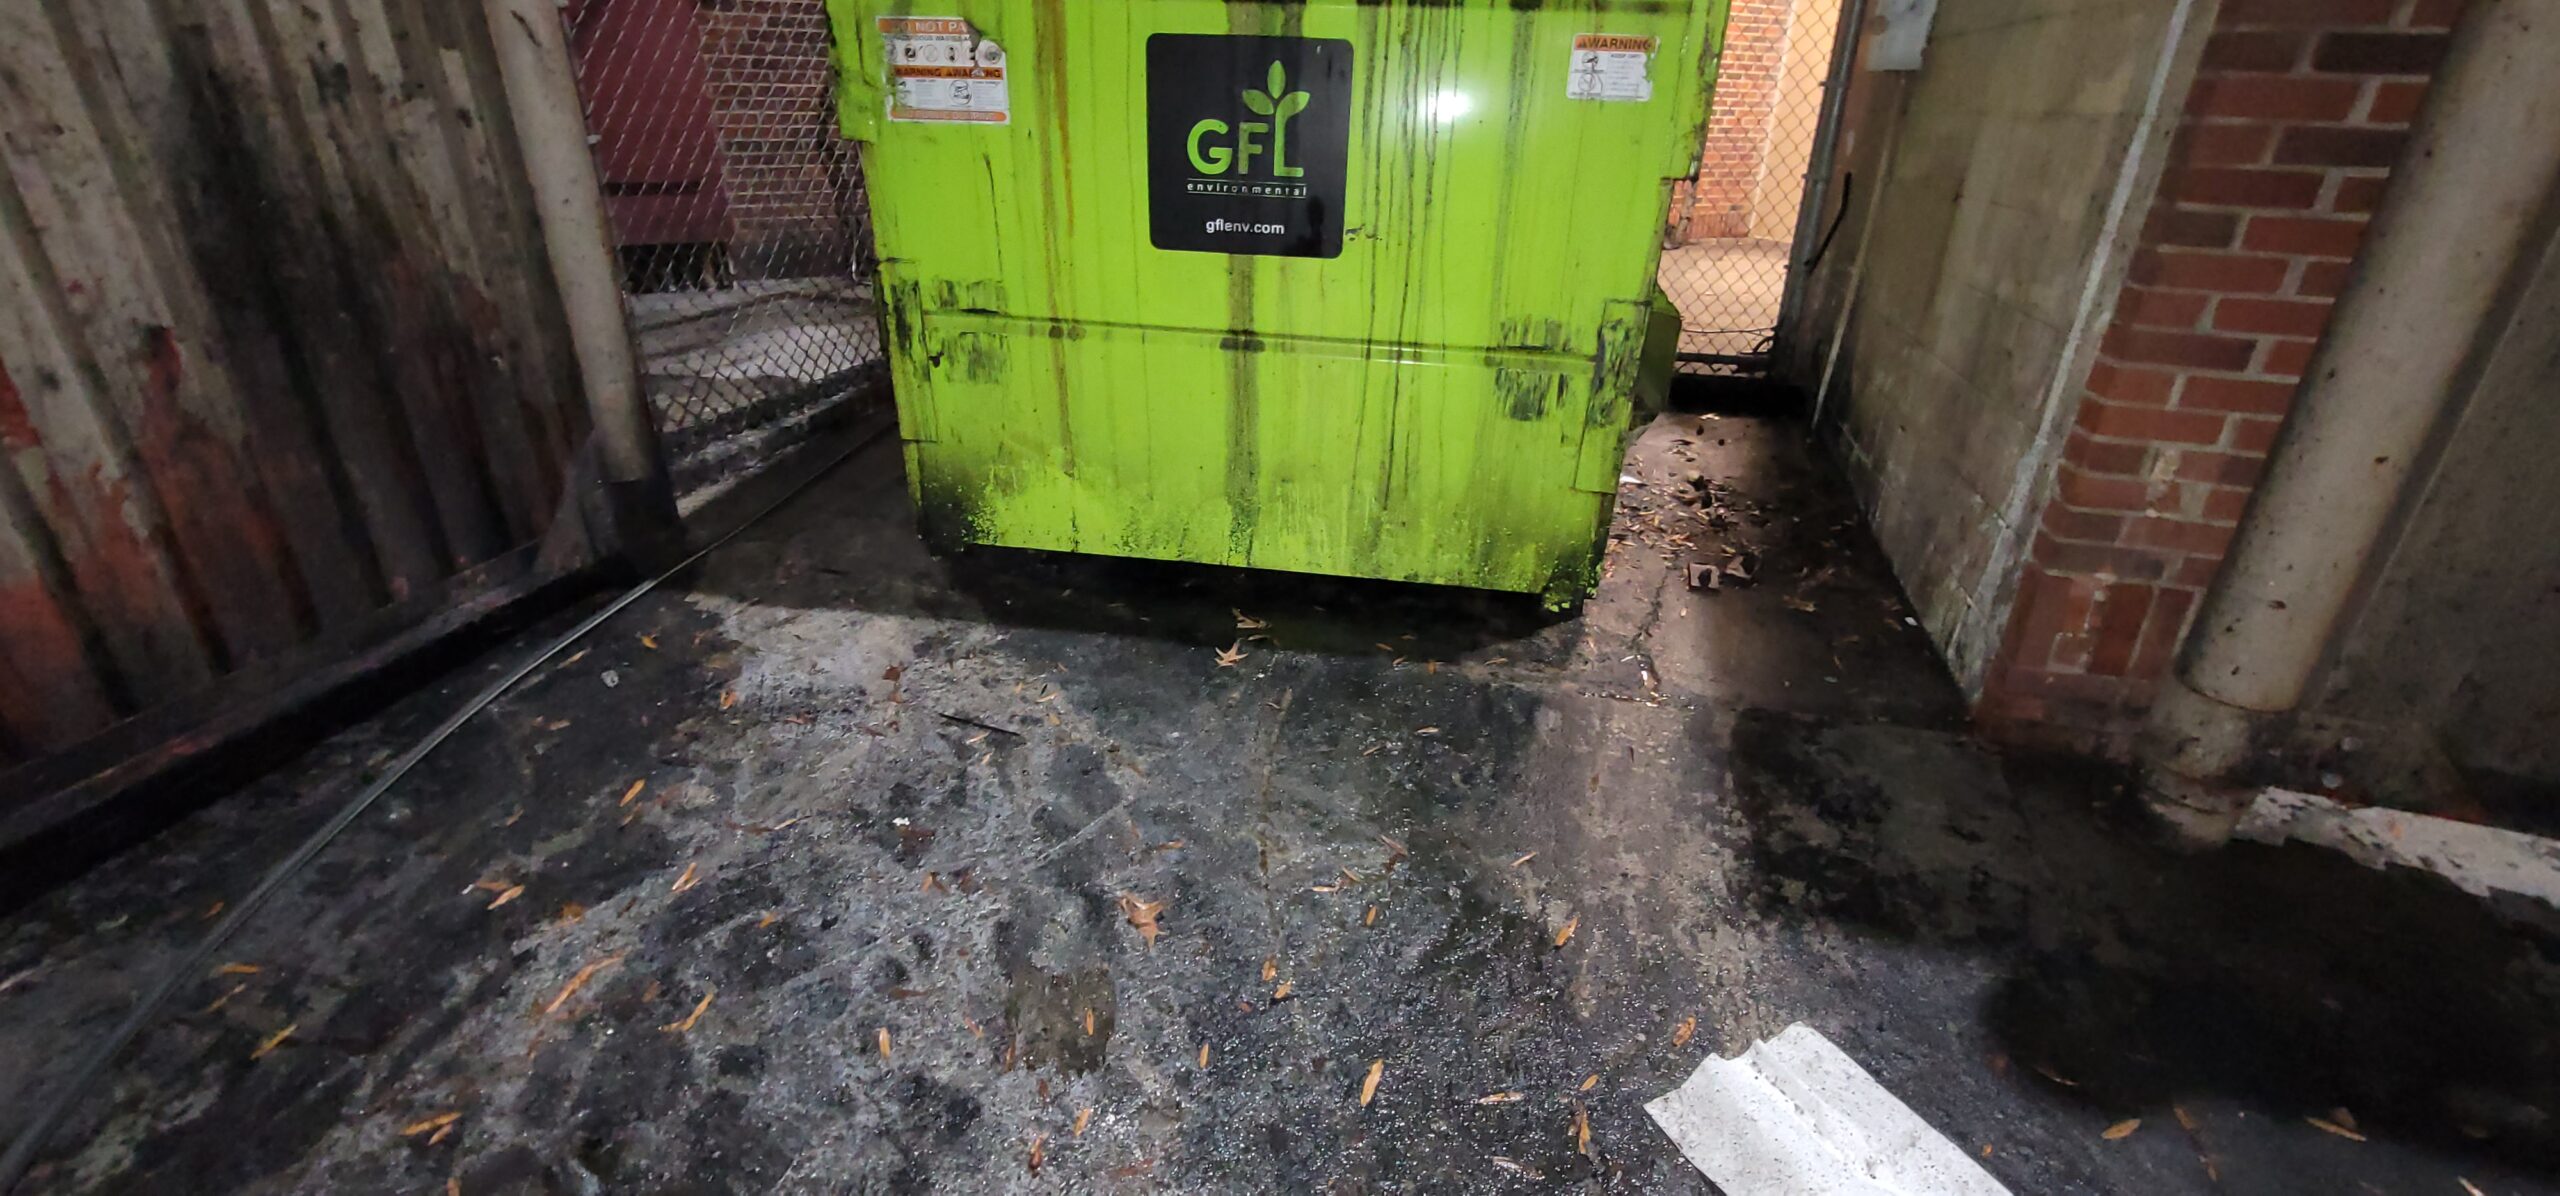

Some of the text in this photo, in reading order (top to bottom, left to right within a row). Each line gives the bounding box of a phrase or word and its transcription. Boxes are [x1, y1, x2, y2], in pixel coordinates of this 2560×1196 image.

[914, 21, 944, 32] NOT
[1588, 38, 1652, 50] WARNING
[895, 67, 1001, 78] WARNING WARNG
[1187, 91, 1310, 177] GFL
[1187, 182, 1307, 196] environmental
[1205, 218, 1285, 235] gflenv.com
